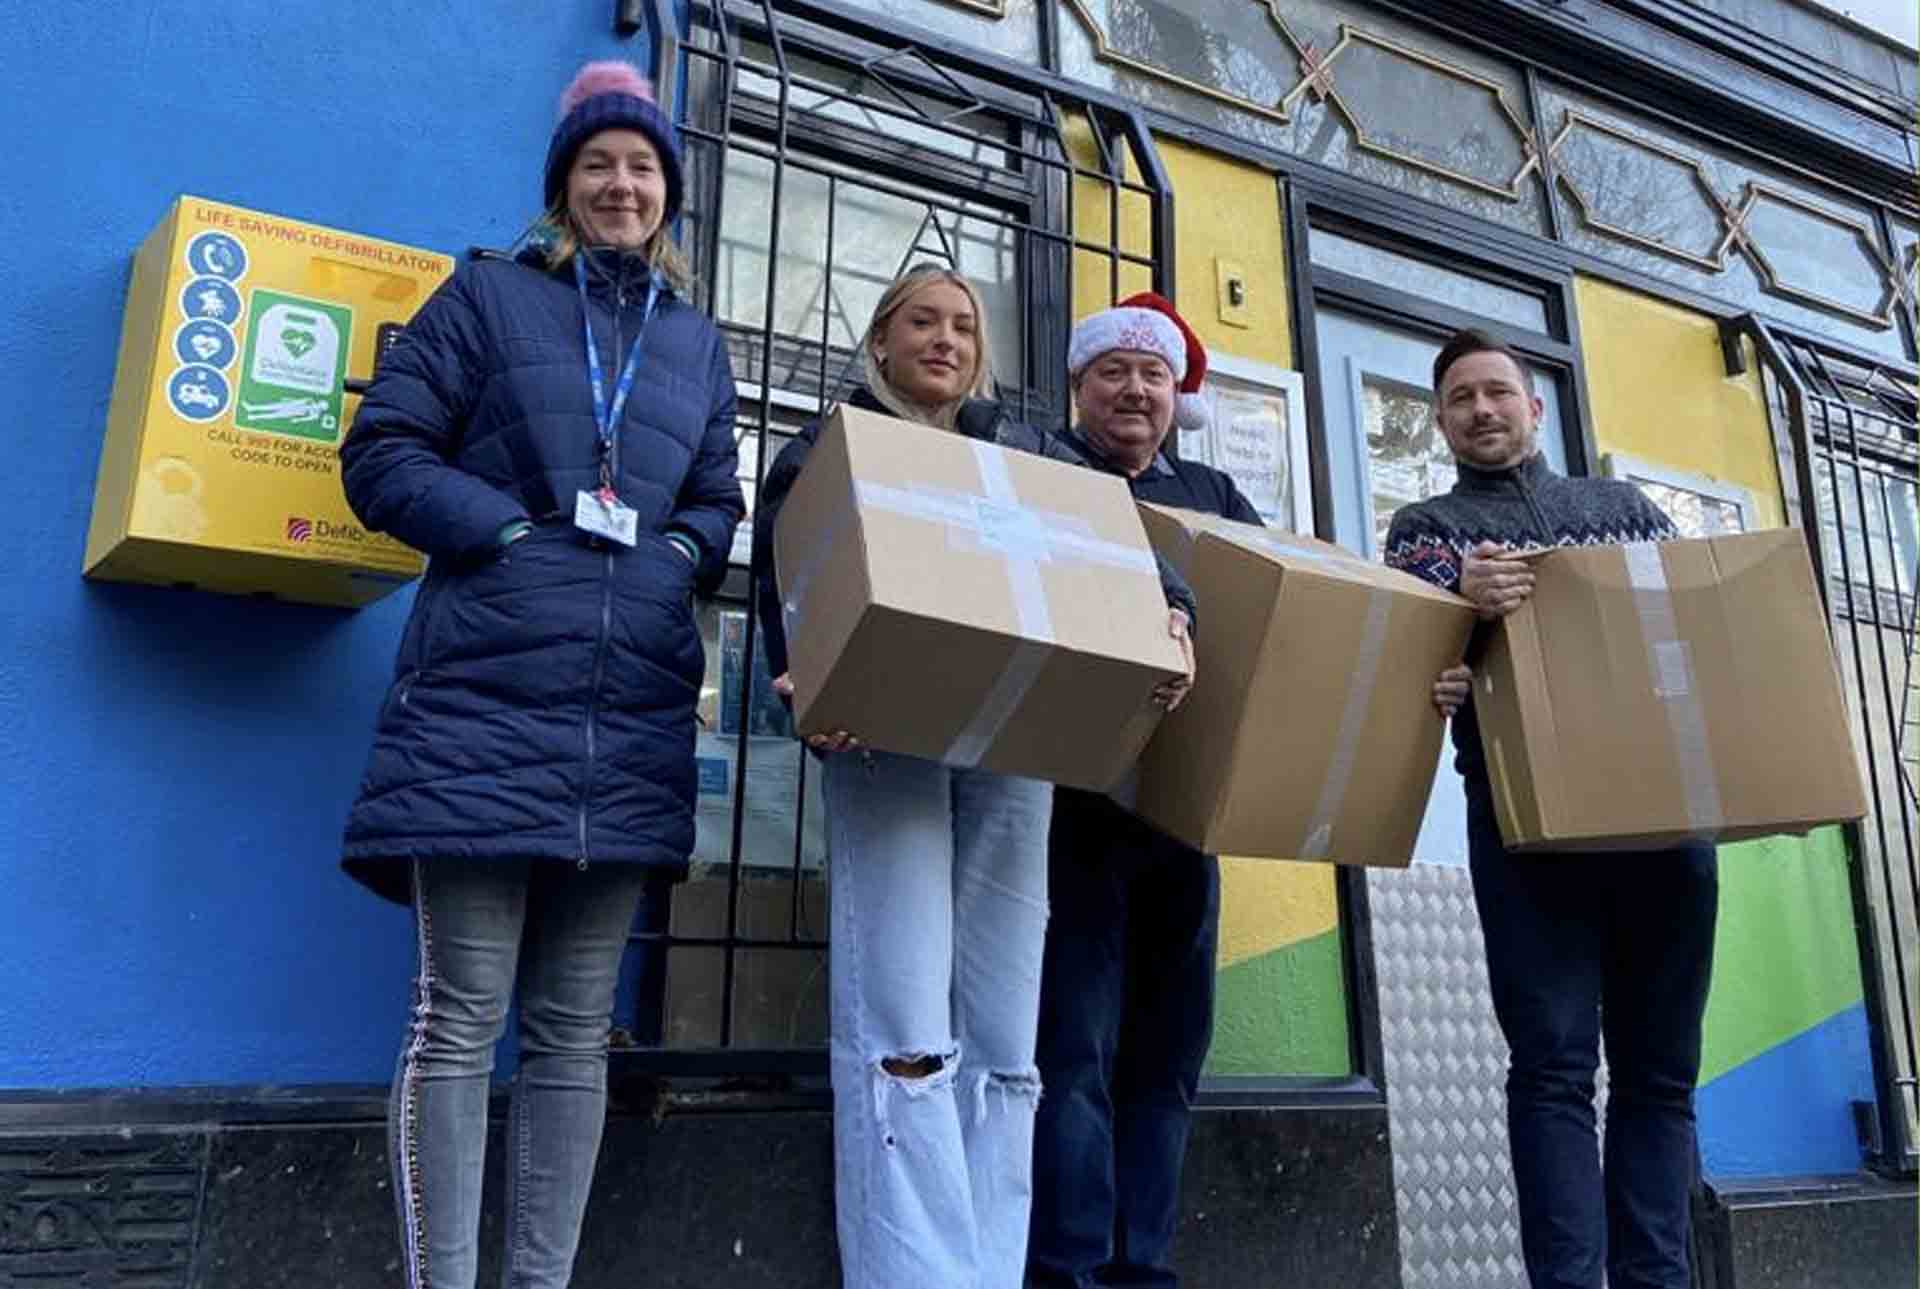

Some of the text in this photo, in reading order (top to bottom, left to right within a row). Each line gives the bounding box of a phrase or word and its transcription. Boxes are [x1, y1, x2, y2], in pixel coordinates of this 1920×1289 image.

[196, 208, 444, 273] LIFE SAVING DEFIBRILLATOR
[207, 429, 240, 444] CALL
[273, 439, 301, 452] FOR
[230, 448, 333, 475] CODE TO OPEN
[315, 519, 380, 542] Defib
